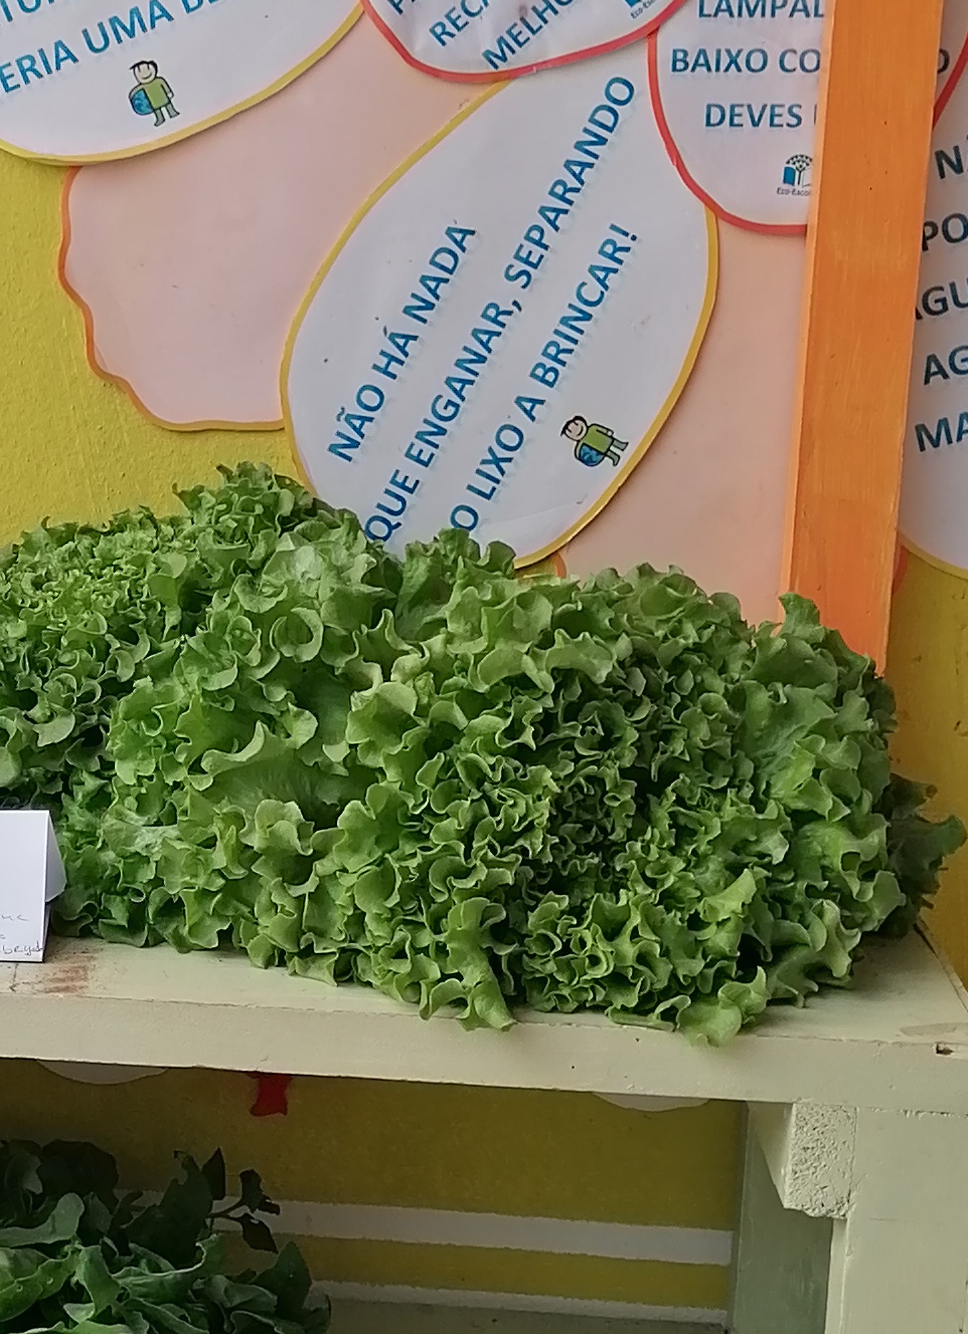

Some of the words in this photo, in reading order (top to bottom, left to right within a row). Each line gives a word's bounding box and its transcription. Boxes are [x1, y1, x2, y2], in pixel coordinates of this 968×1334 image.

[670, 48, 768, 74] BAIXO
[705, 103, 803, 129] DEVES
[364, 469, 420, 543] QUE
[405, 299, 522, 468] ENGANAR,
[503, 75, 634, 290] SEPARANDO
[528, 223, 638, 388] BRINCAR!
[914, 278, 968, 320] GU
[327, 384, 384, 463] NÃO
[372, 325, 418, 380] HÁ
[403, 224, 476, 325] NADA
[514, 394, 546, 422] A
[466, 423, 525, 501] LIXO
[450, 504, 479, 533] O
